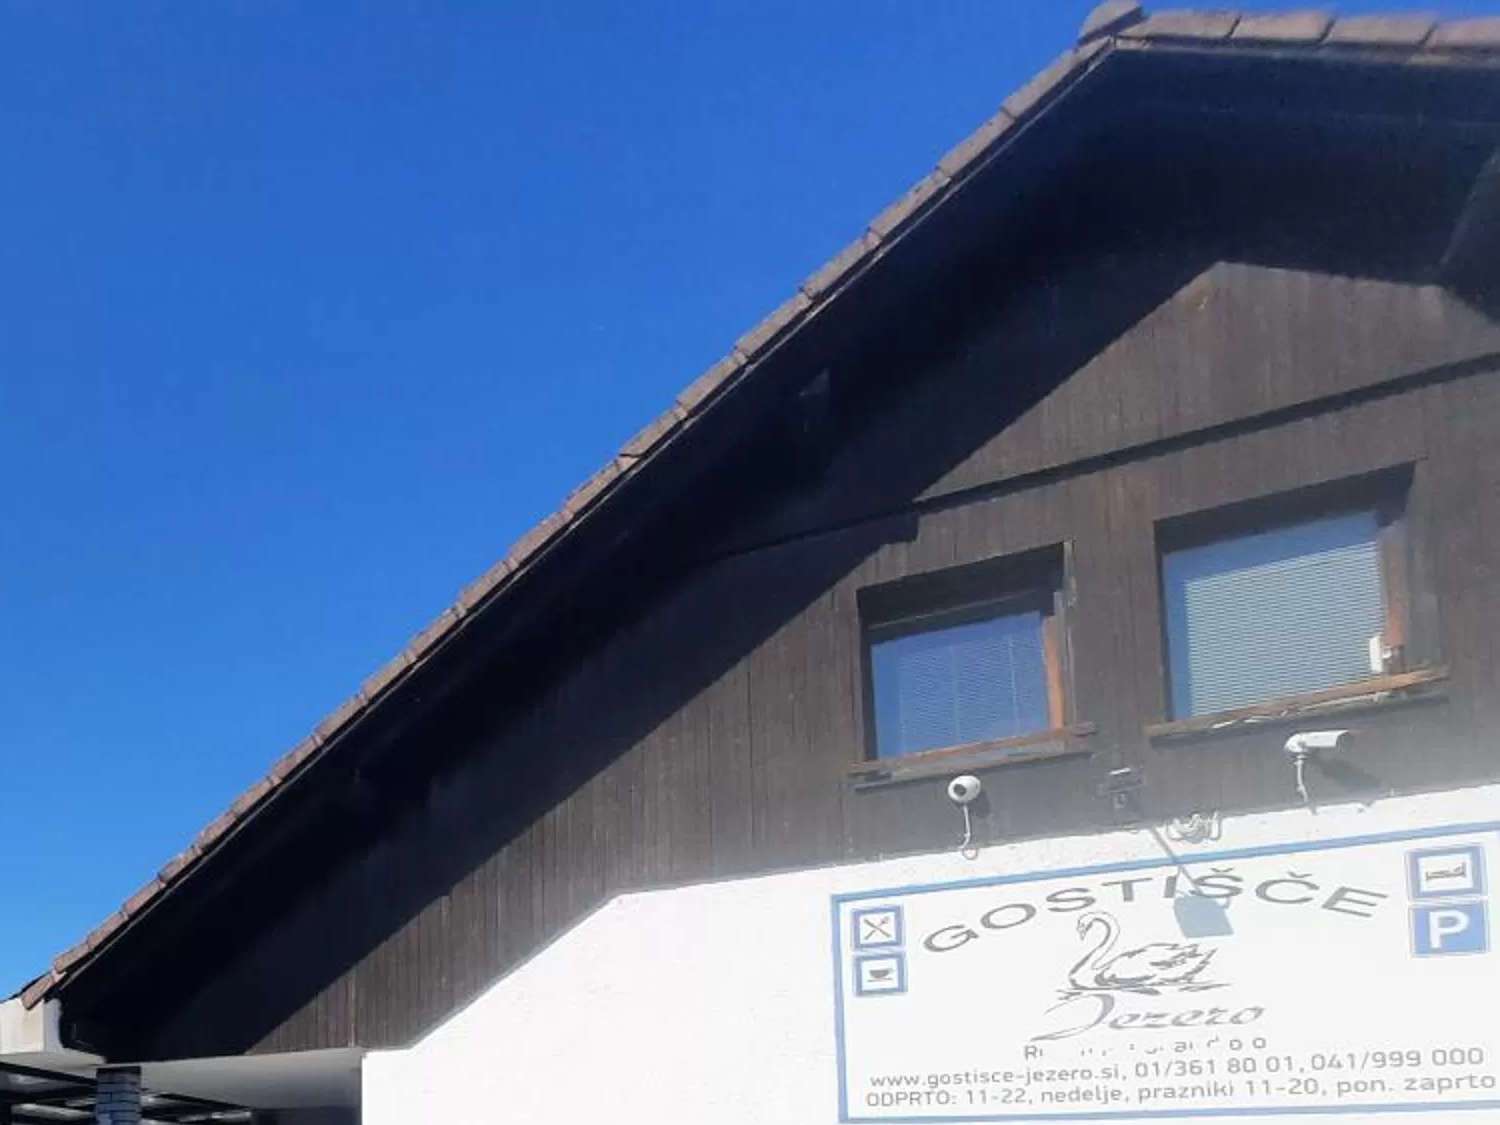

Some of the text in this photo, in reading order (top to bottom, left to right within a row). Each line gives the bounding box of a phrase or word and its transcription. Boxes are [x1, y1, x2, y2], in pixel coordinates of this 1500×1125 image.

[922, 866, 1389, 953] GOSTIŠČE
[1427, 909, 1469, 949] P
[1030, 993, 1267, 1041] Jezero
[870, 1063, 1128, 1089] www.gostisce-jezero.si,
[1134, 1057, 1217, 1078] 01/361
[1227, 1056, 1257, 1074] 80
[1431, 1047, 1485, 1066] 000
[866, 1072, 1497, 1107] ODPRTO: 11-22, nedelje, prazniki 11-20, pon. zaprto
